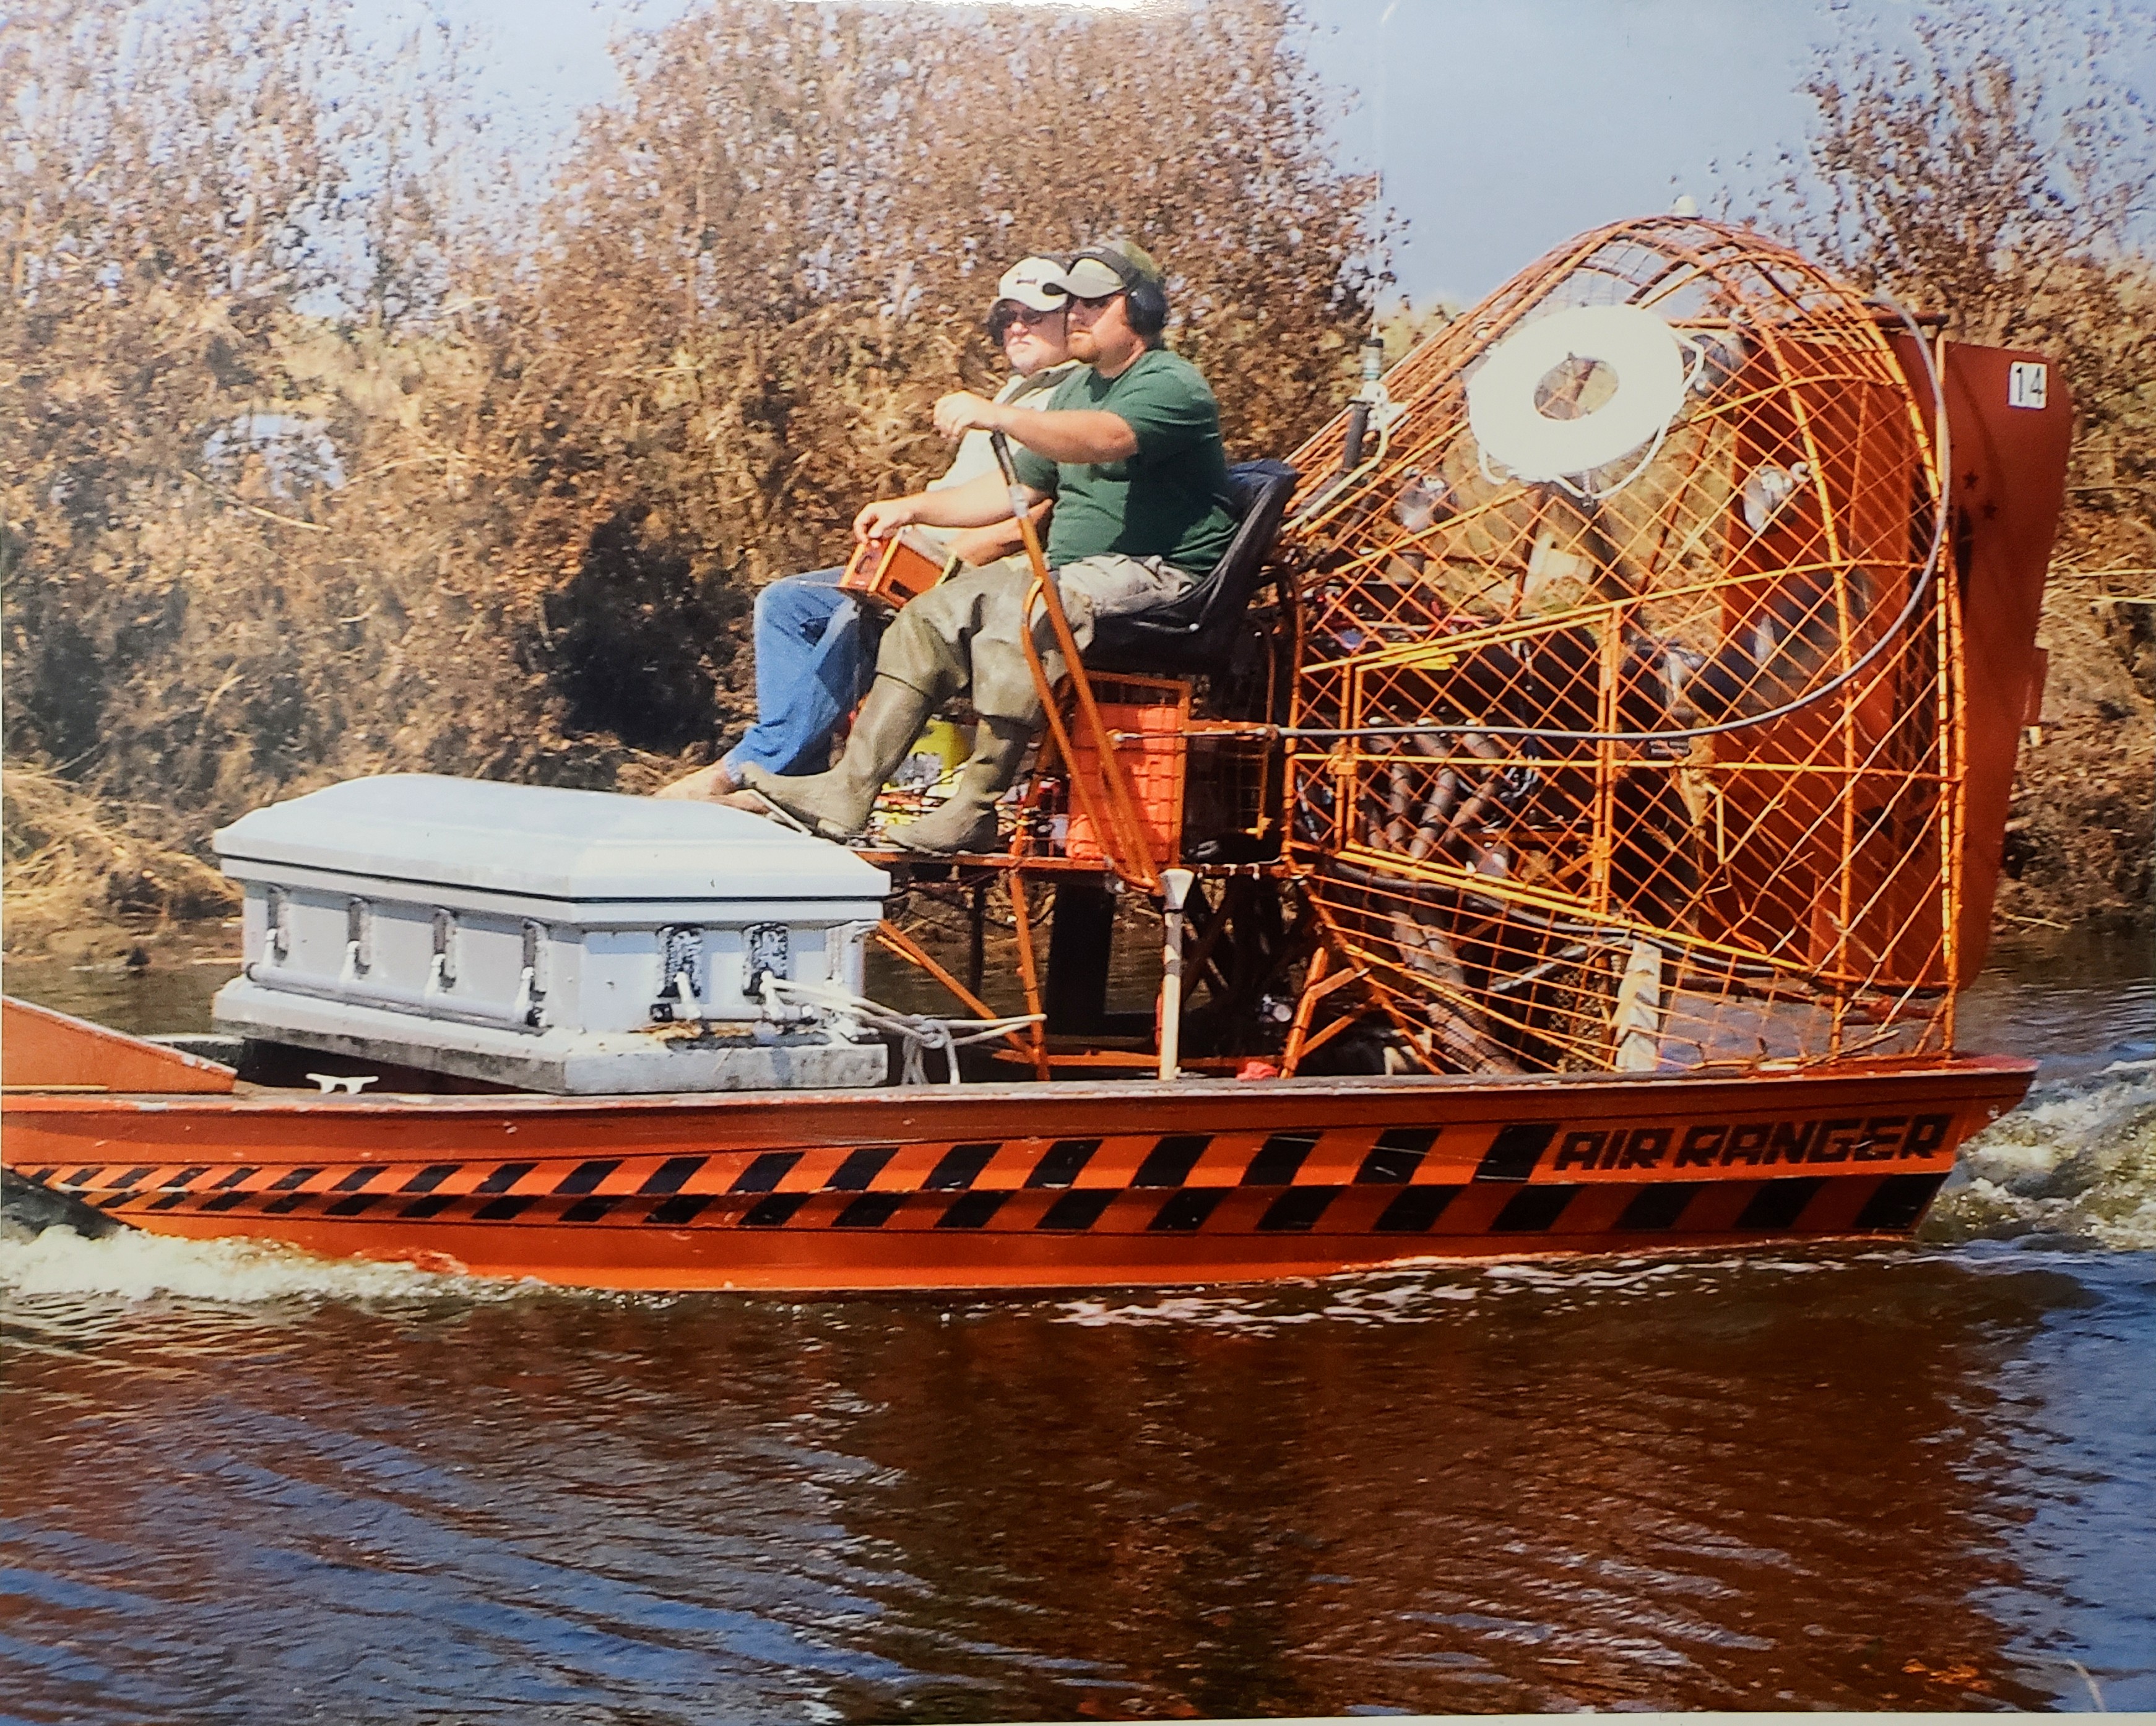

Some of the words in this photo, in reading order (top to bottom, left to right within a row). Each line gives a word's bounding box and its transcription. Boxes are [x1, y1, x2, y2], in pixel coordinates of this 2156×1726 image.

[2016, 366, 2043, 403] 14
[1554, 1128, 1673, 1170] AIR
[1674, 1114, 1953, 1167] RANGER
